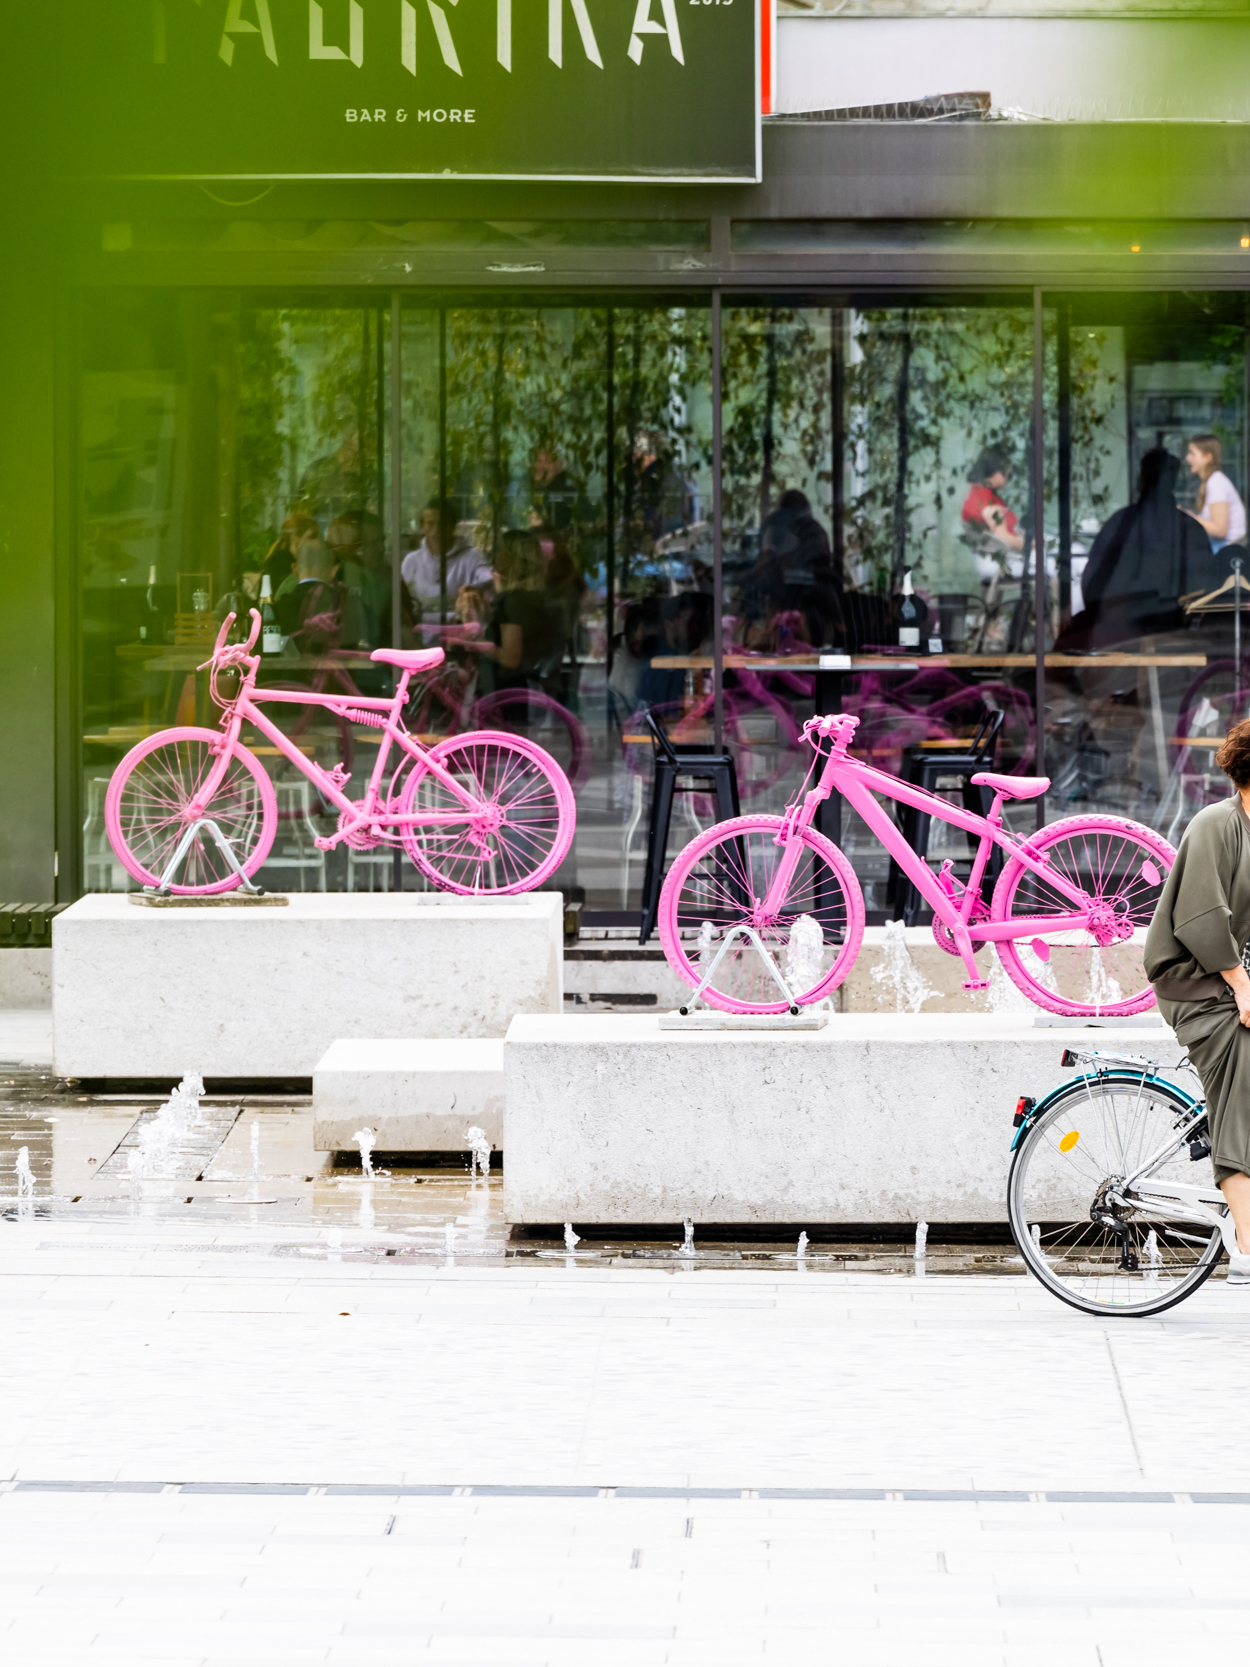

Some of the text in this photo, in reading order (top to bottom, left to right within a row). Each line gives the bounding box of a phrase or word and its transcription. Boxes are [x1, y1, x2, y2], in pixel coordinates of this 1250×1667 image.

[345, 108, 476, 123] BAR & MORE
